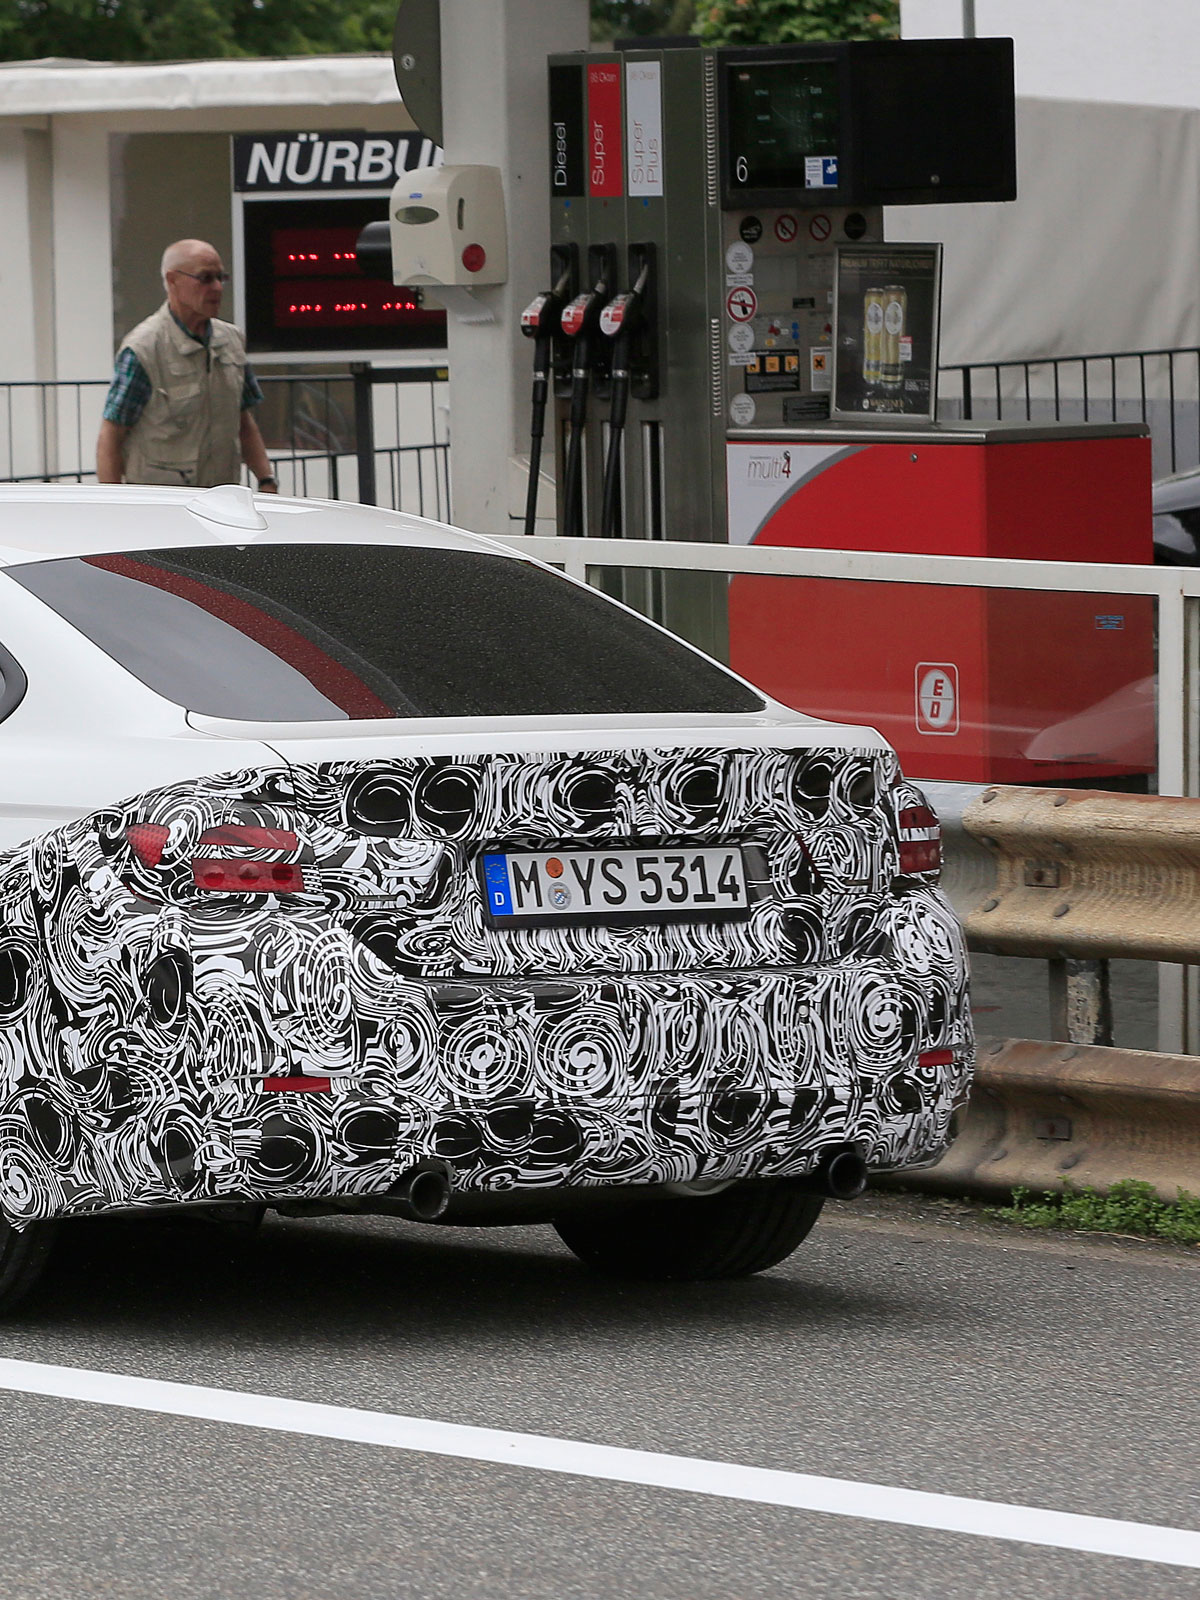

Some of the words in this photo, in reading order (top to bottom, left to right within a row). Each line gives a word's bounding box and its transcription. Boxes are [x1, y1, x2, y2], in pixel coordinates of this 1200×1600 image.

[554, 122, 567, 186] Diesel
[592, 121, 606, 186] Super
[631, 120, 645, 184] Super
[647, 138, 659, 183] Plus
[736, 156, 749, 183] 6
[933, 679, 945, 696] E
[494, 892, 505, 906] D
[511, 860, 543, 908] M
[569, 857, 627, 905] YS
[636, 854, 740, 904] 5314
